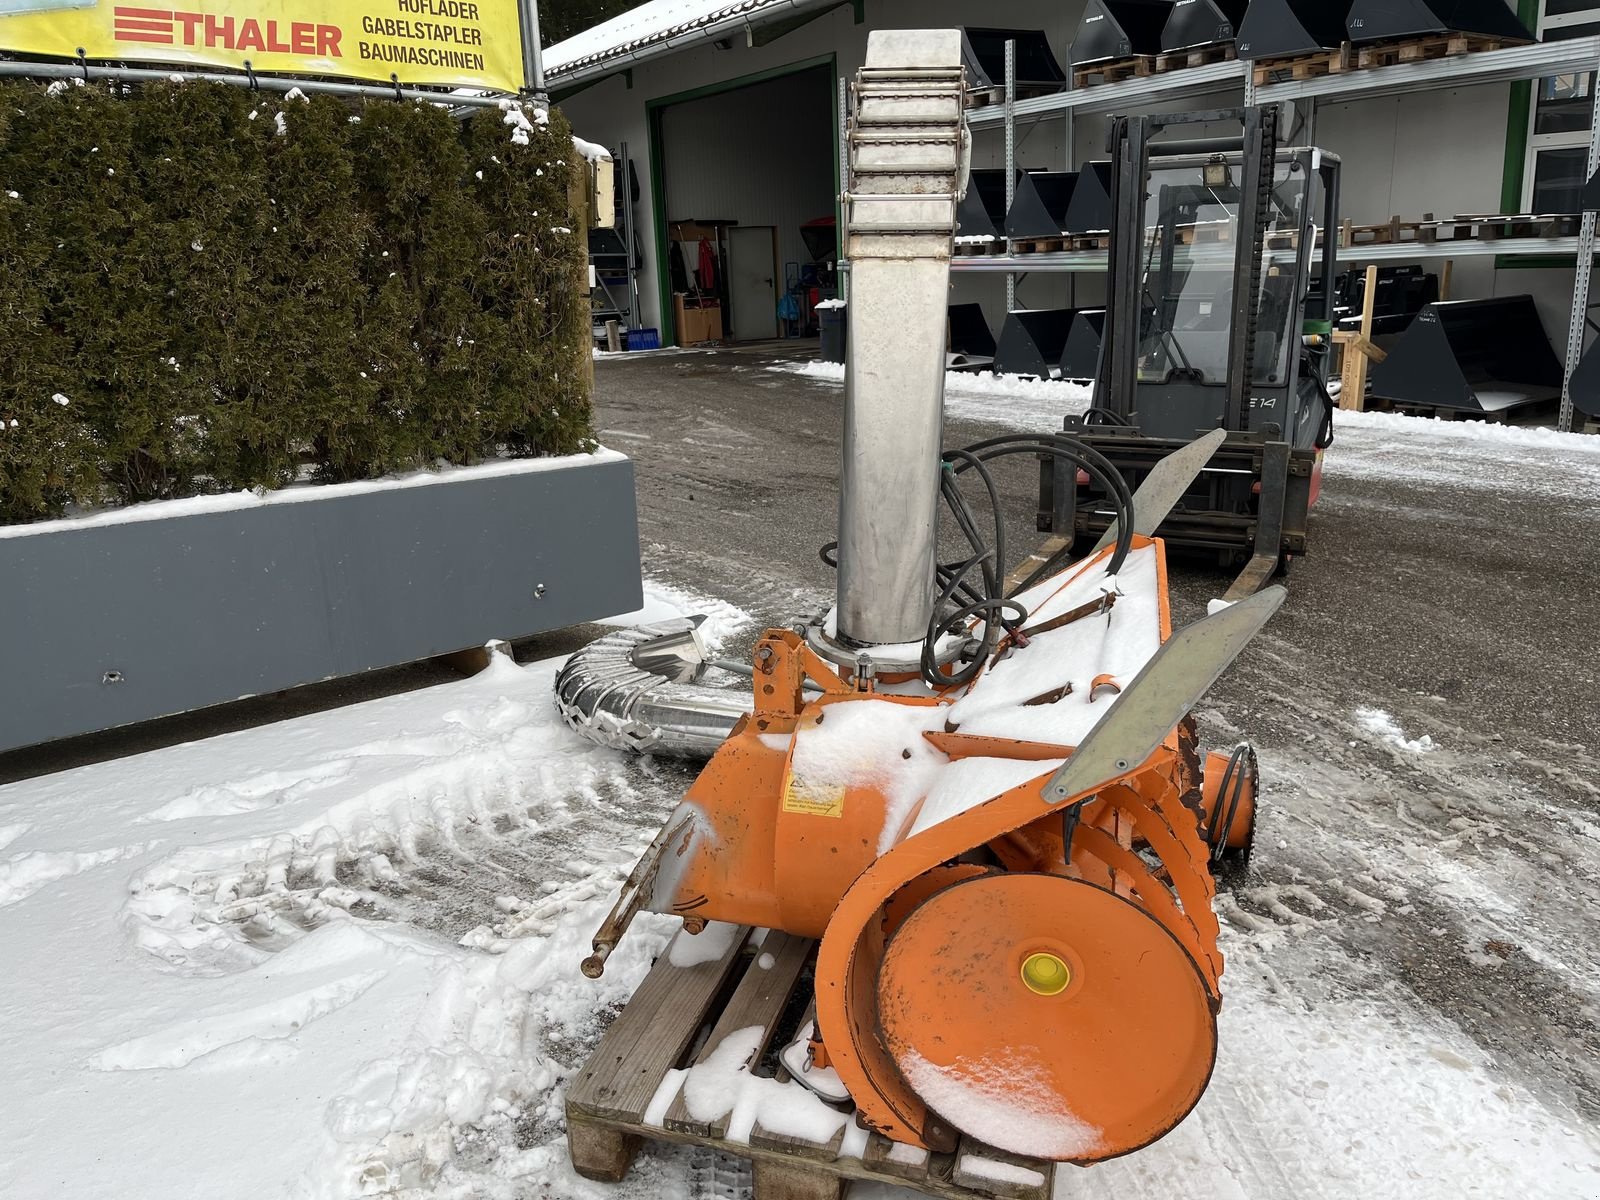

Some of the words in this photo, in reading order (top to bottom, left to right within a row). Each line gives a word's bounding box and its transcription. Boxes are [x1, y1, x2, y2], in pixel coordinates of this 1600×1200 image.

[399, 0, 480, 21] HOFLADER
[174, 11, 343, 58] THALER
[362, 16, 482, 46] GABELSTAPLER
[359, 42, 485, 71] BAUMASCHINEN
